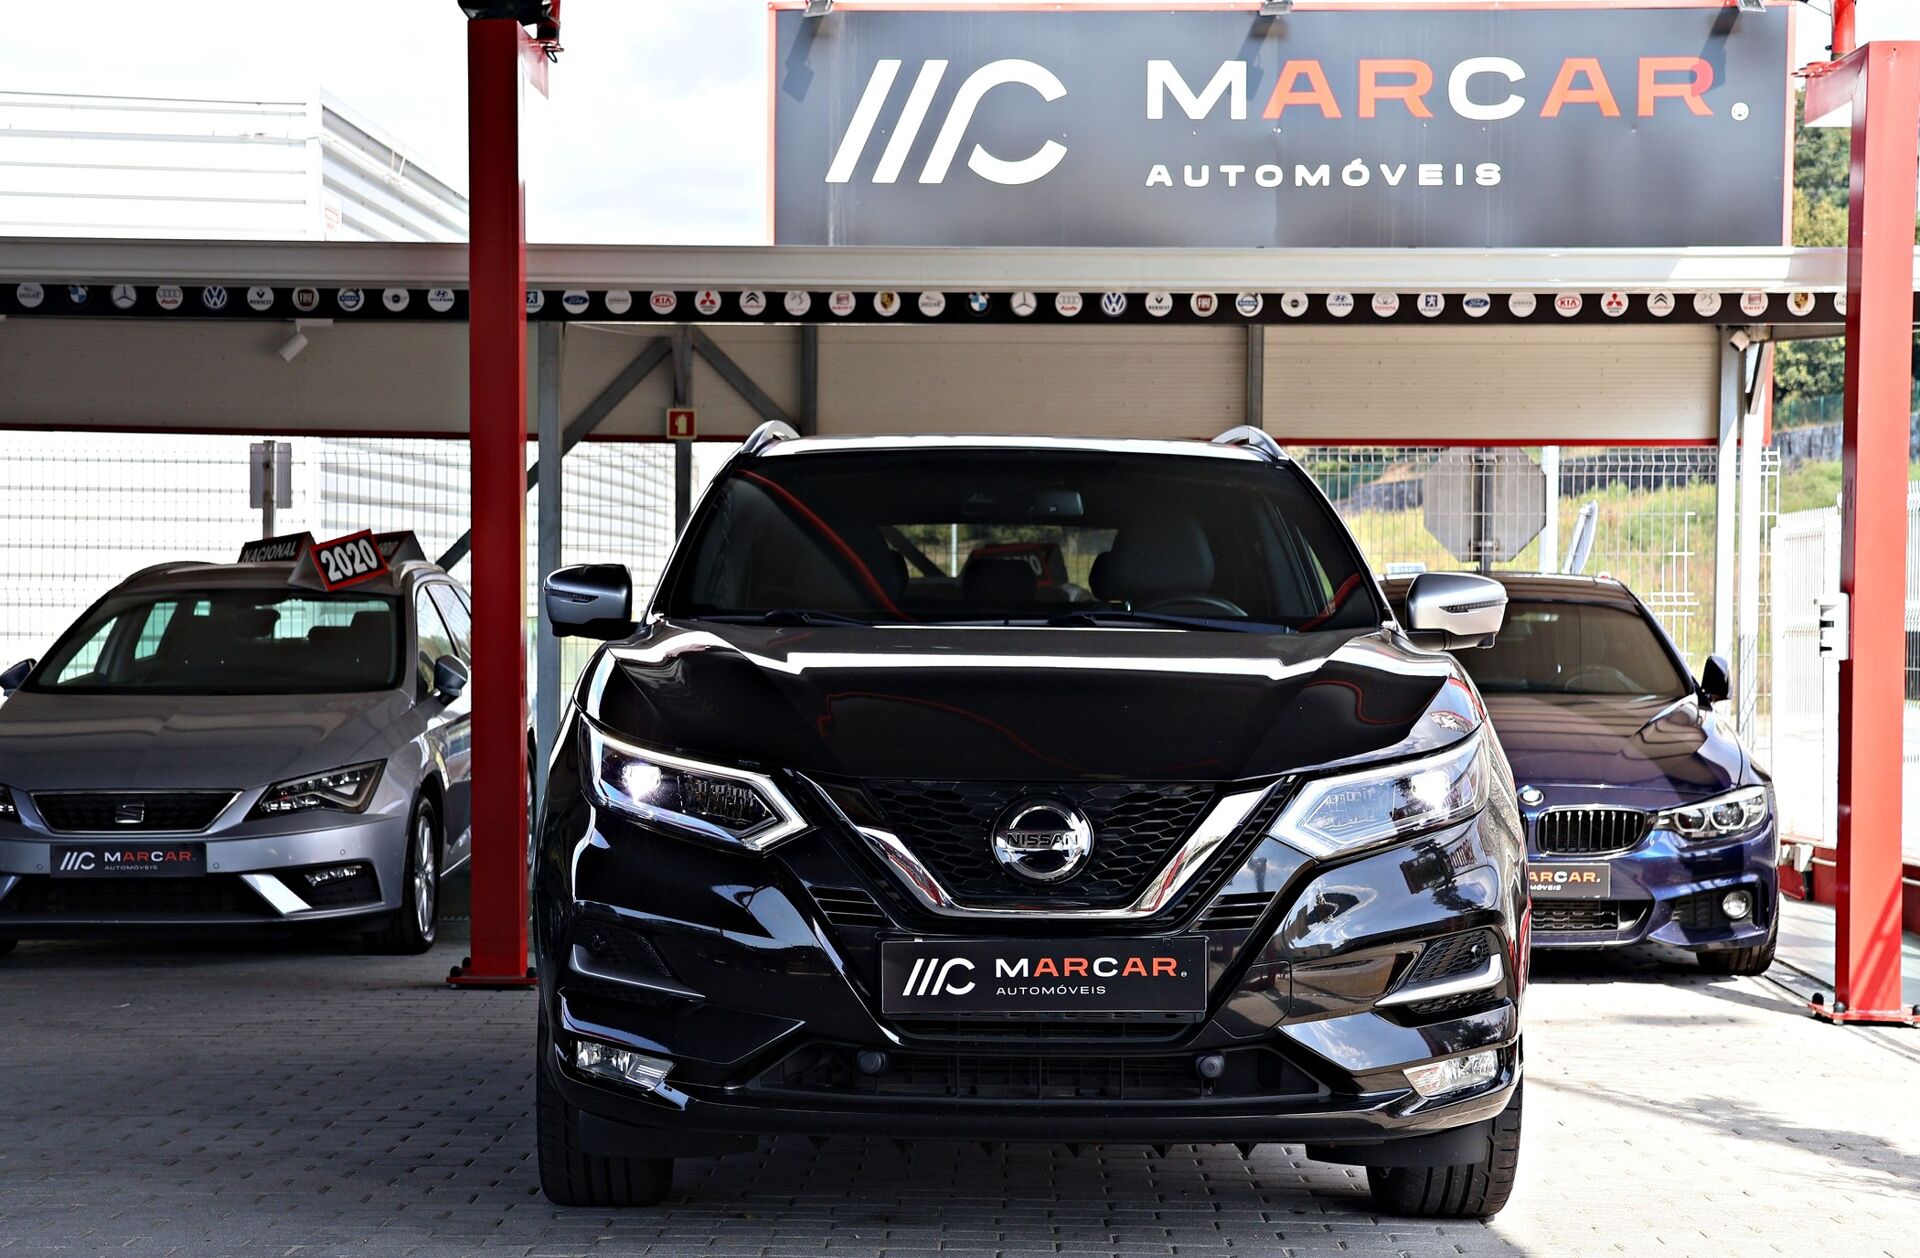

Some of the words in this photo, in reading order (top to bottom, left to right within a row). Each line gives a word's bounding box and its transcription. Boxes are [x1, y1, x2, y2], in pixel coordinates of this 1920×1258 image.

[1145, 157, 1503, 188] AUTOMÓVEIS
[241, 541, 297, 563] NACIONAL
[321, 539, 378, 582] 2020
[1007, 832, 1079, 847] NISSAN
[105, 863, 158, 871] AUTOMÓVEIS
[996, 984, 1107, 996] AUTOMÓVEIS
